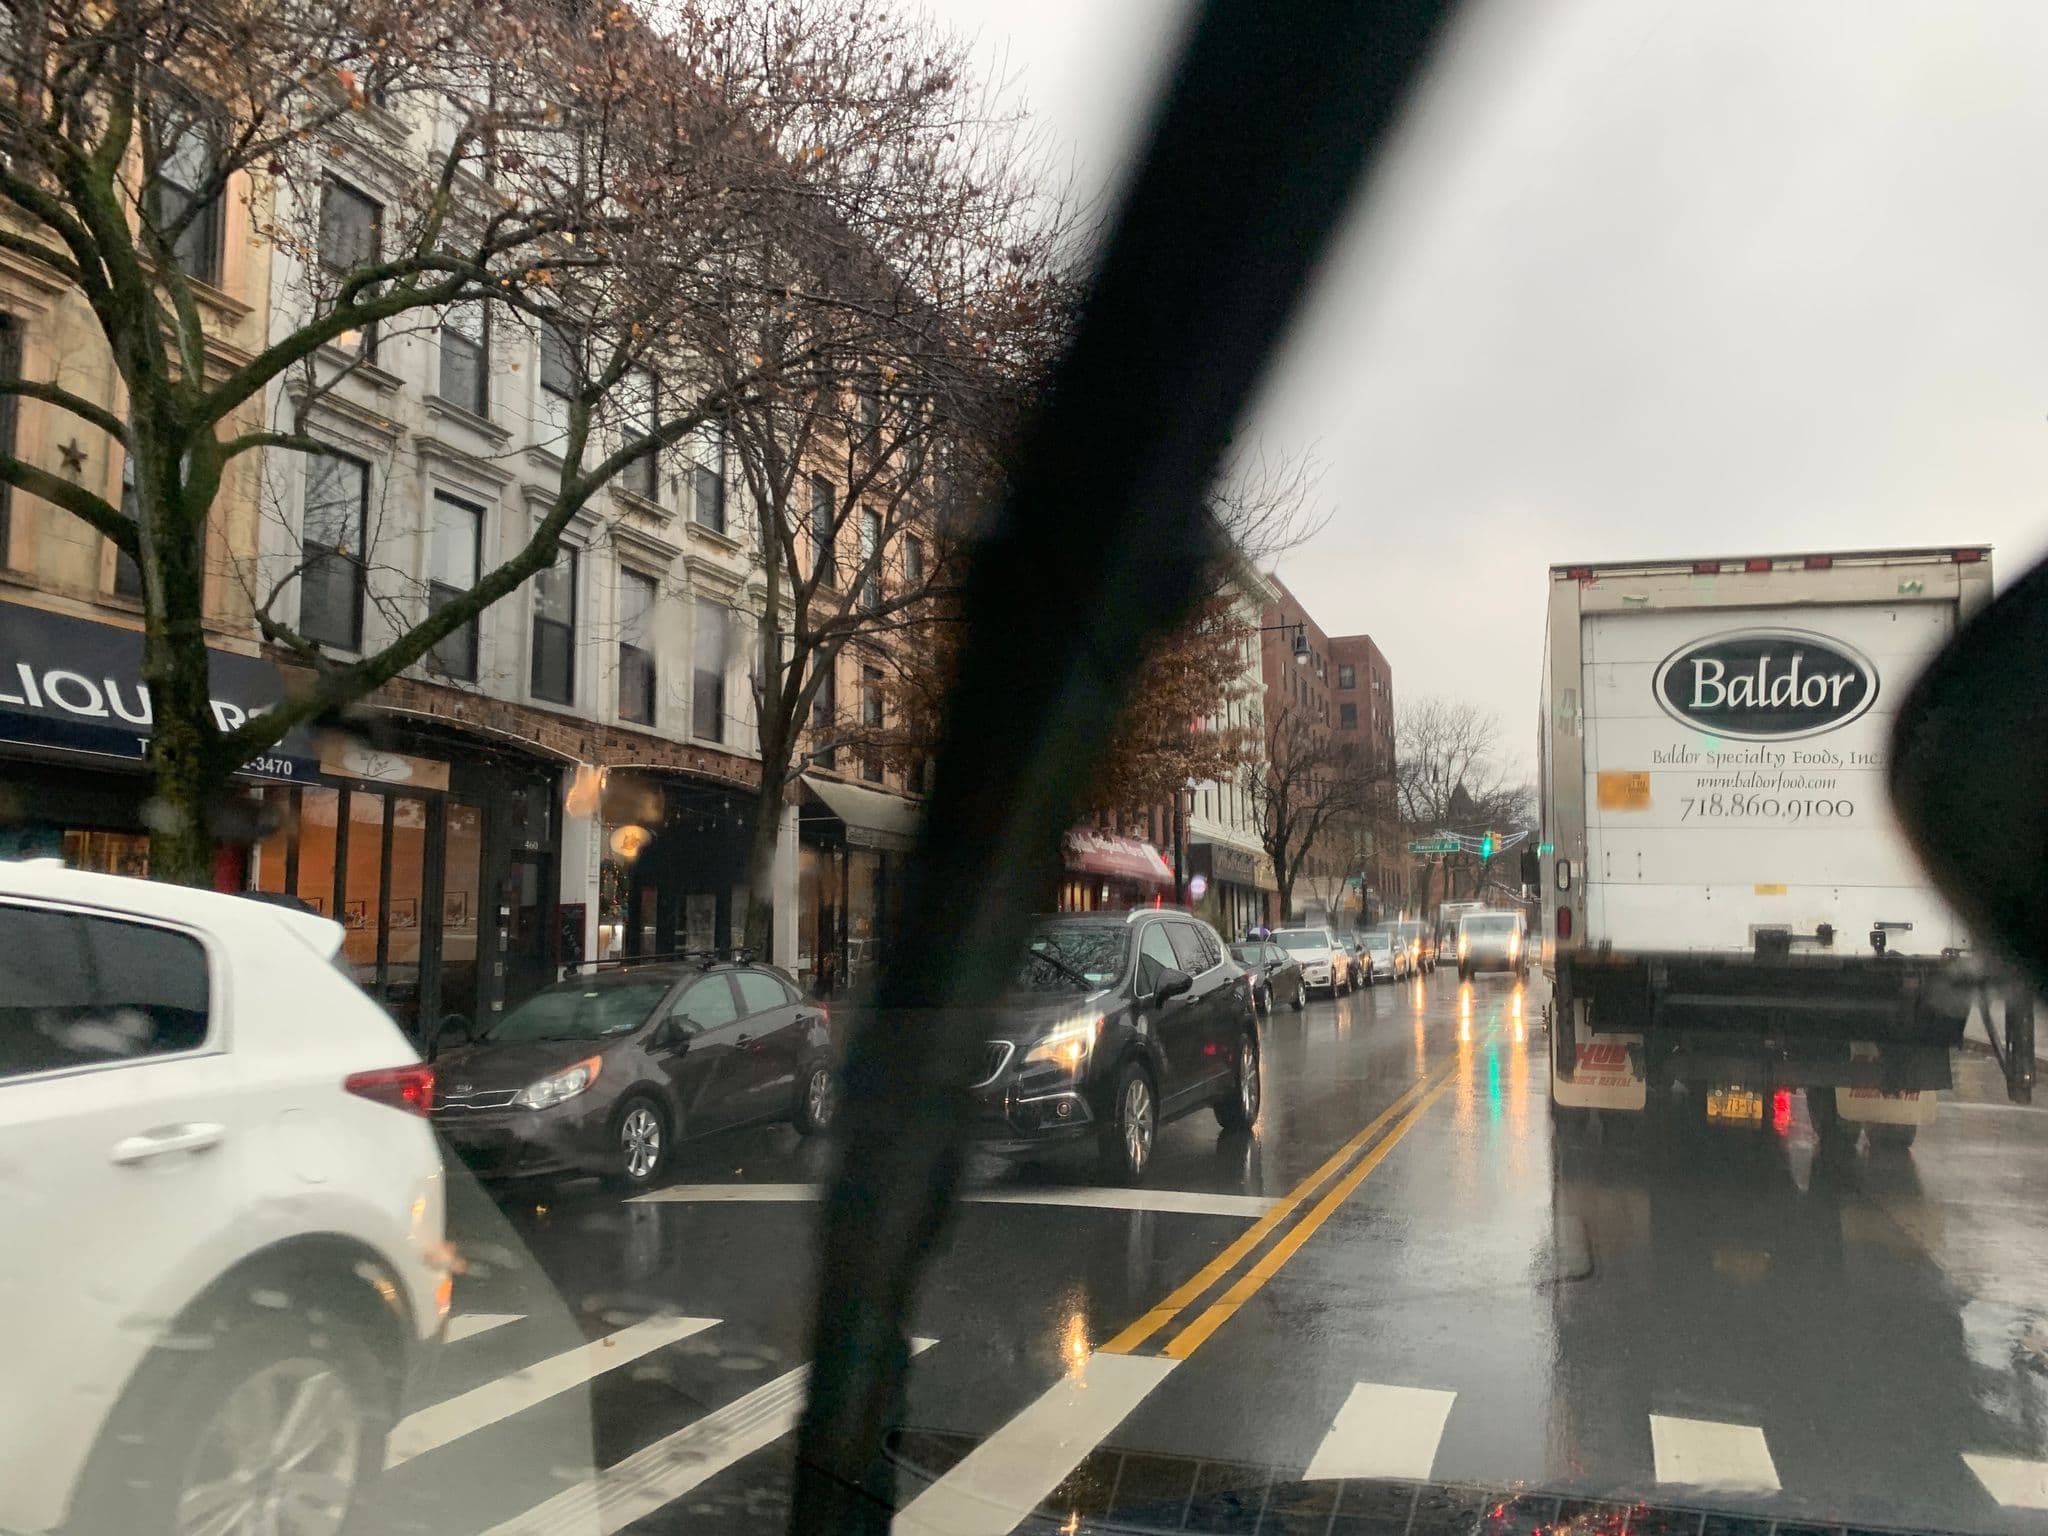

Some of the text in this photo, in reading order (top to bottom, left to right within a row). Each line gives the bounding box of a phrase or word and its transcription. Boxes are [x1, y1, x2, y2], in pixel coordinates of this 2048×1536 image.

[1688, 653, 1855, 708] Baldor
[1652, 744, 1702, 765] Baldor
[1706, 744, 1787, 769] Specialty
[1792, 750, 1845, 768] Foods,
[1696, 771, 1837, 792] www.baldorfood.com
[1680, 793, 1855, 822] 718.860.9100
